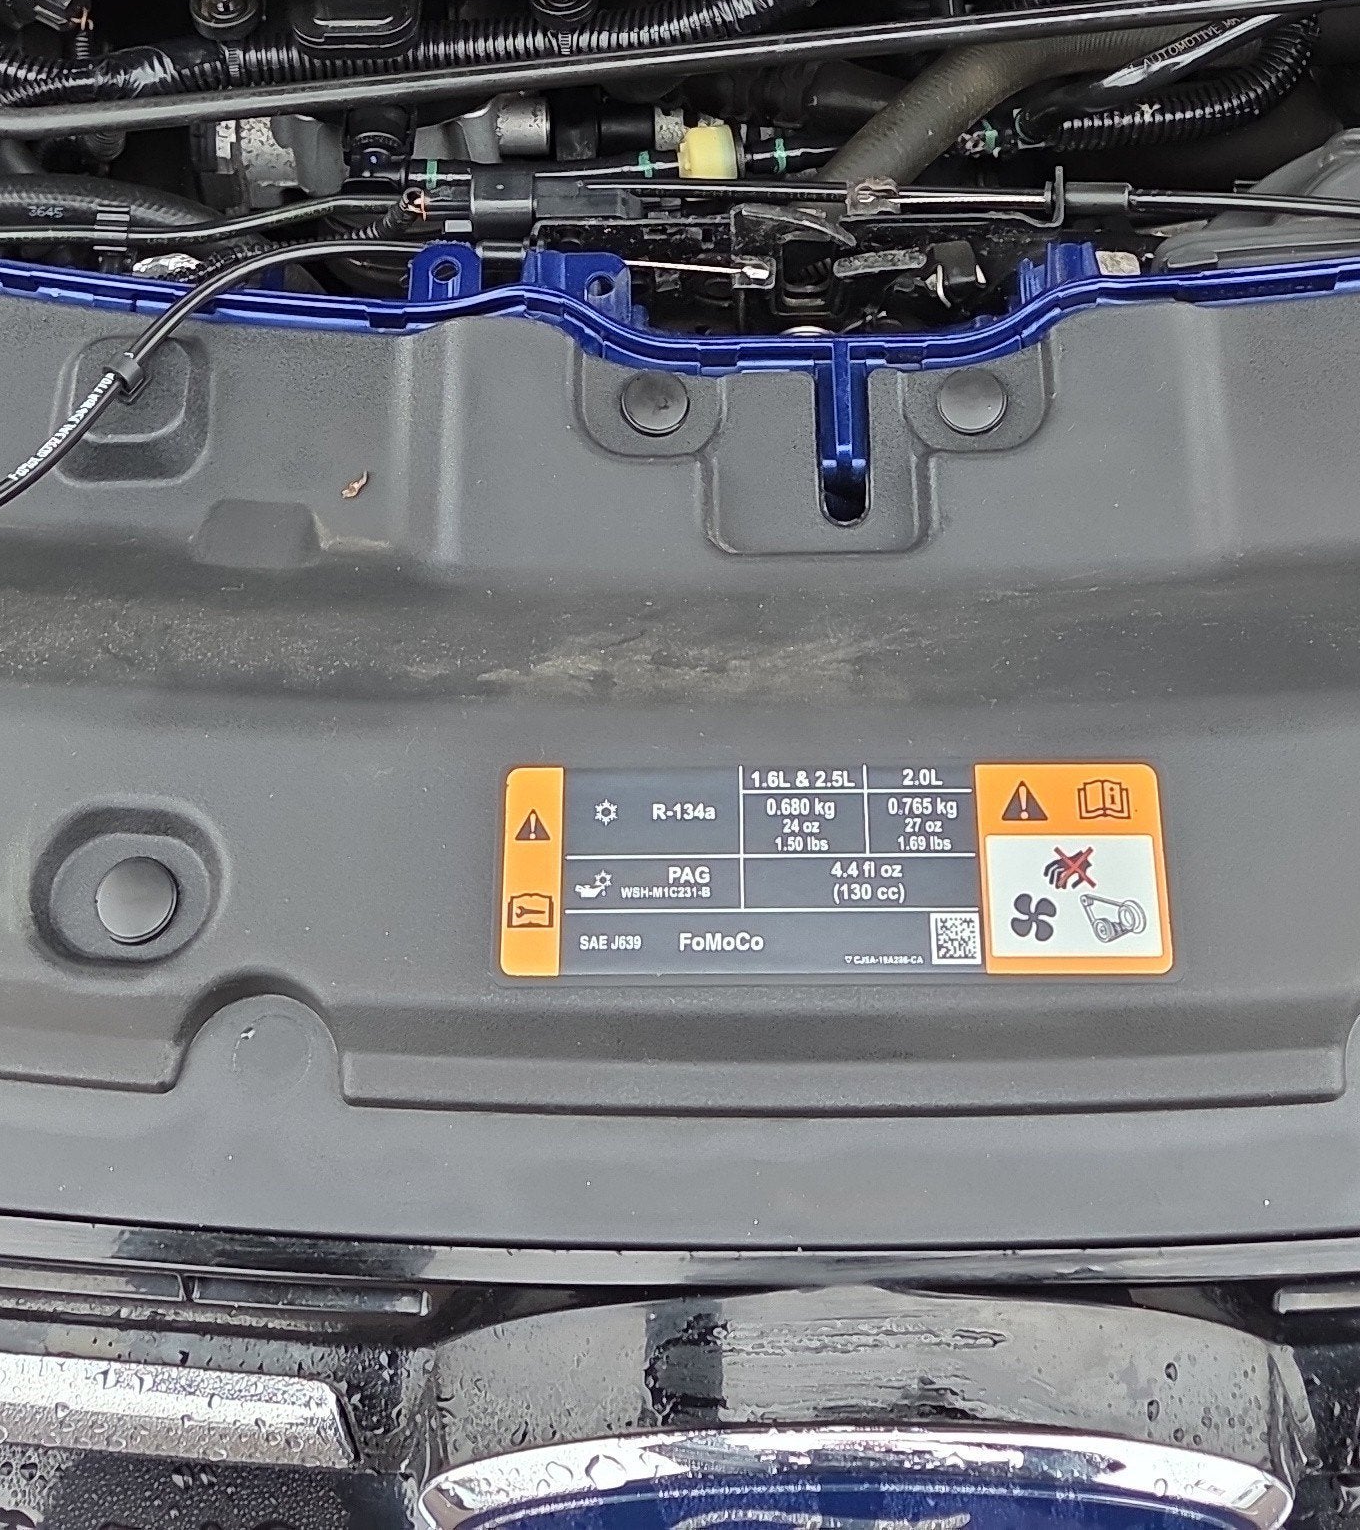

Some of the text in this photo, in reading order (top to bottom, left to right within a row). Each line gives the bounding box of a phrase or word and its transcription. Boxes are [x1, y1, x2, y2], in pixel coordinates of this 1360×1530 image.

[1142, 25, 1222, 67] AUTOMOTIVE
[28, 207, 64, 218] 3645
[751, 770, 855, 788] 1.6L & 2.5L
[902, 769, 943, 786] 2.0L
[652, 802, 716, 821] R-134a
[766, 798, 835, 819] 0.680 kg
[887, 797, 957, 818] 0.765 kg
[782, 819, 820, 834] 24 oz
[904, 818, 943, 833] 27 oz
[774, 836, 829, 851] 1.50 lbs
[897, 835, 952, 851] 1.69 lbs
[668, 866, 711, 884] PAG
[830, 861, 903, 878] 4.4 fl oz
[833, 882, 905, 904] (130 cc)
[579, 935, 642, 950] SAE J639
[679, 932, 764, 951] FoMoCo
